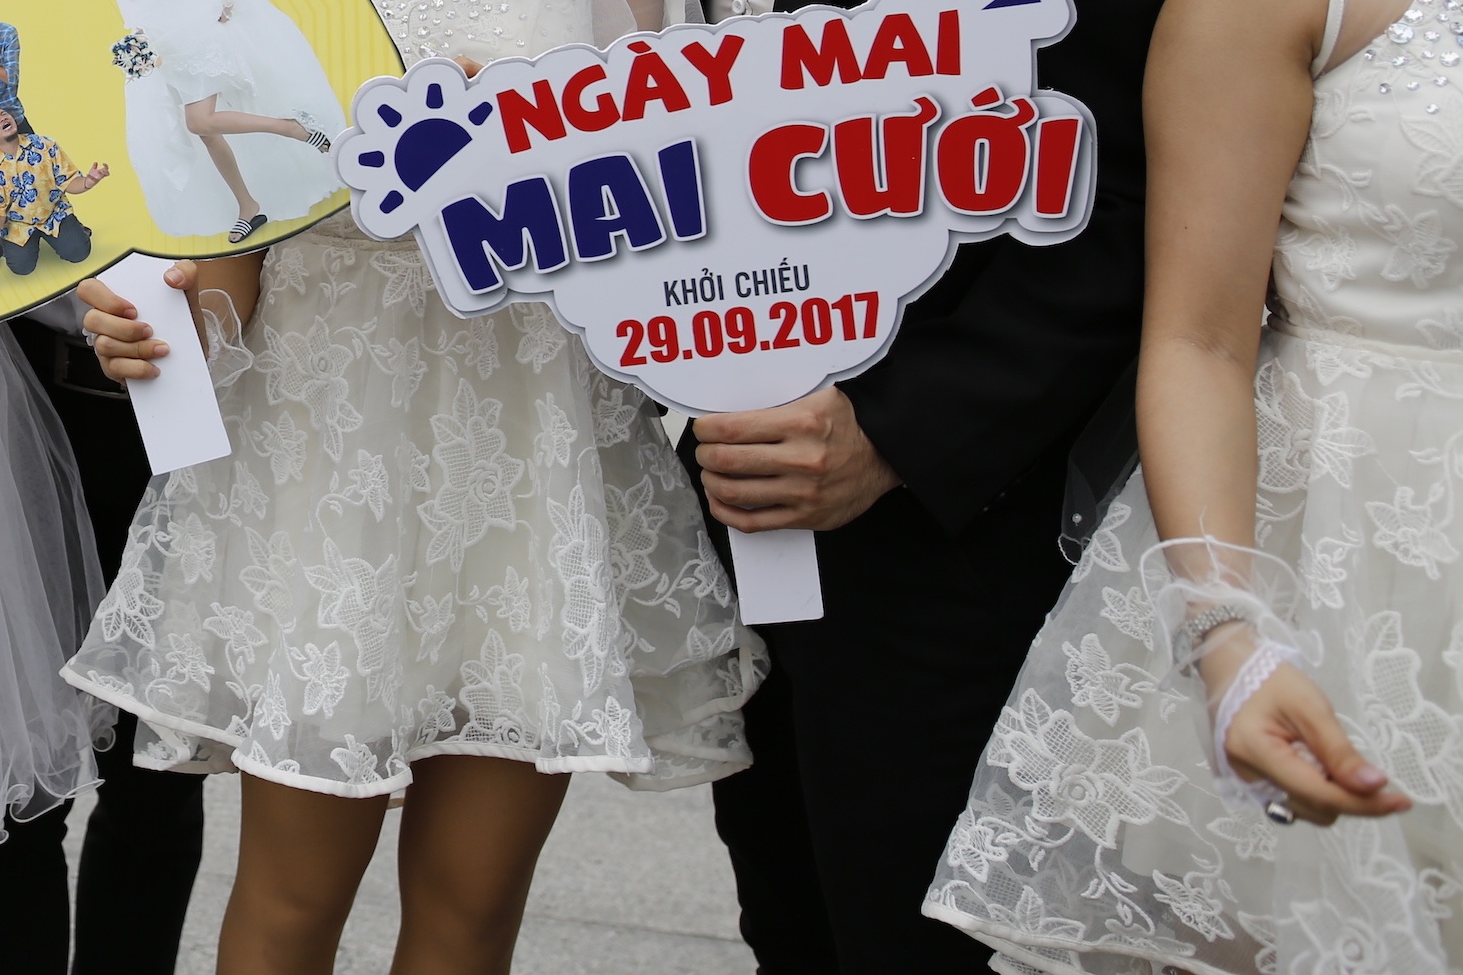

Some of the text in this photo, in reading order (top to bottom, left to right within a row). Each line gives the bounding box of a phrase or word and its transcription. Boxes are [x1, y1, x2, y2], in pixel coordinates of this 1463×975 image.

[496, 9, 961, 154] NGÀY MAI
[440, 86, 1080, 292] MAI CƯỚI
[616, 290, 880, 368] 29.09.2017
[663, 257, 811, 307] KHỞI CHIẾU
